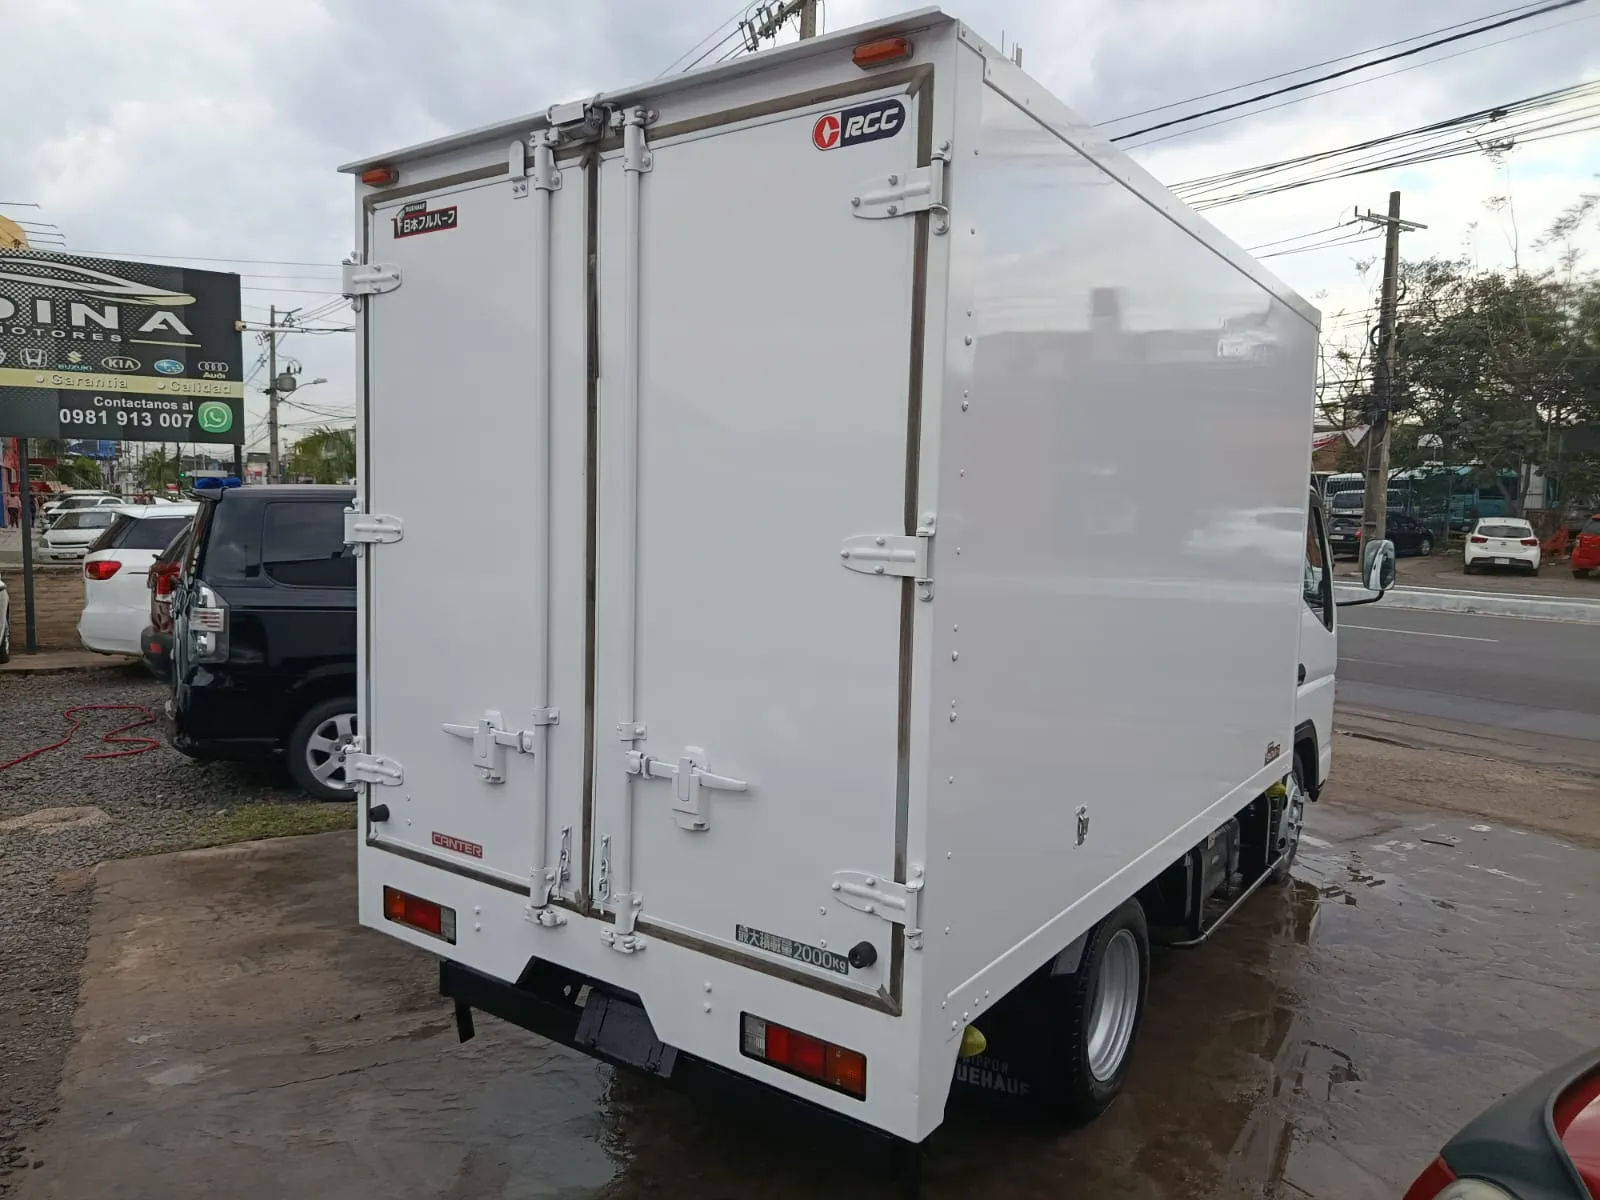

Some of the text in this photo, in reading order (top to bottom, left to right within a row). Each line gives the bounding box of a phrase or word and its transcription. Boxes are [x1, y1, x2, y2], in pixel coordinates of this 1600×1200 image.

[844, 107, 899, 139] RCC
[403, 210, 455, 233] 日本フルハーフ
[0, 325, 122, 343] OTORES
[108, 358, 134, 369] KIA
[170, 381, 232, 395] Calidad
[93, 396, 194, 411] Contactanos al
[59, 408, 194, 428] 0981 913 007
[433, 833, 482, 857] CANTER
[956, 1064, 1032, 1096] UEHAUF
